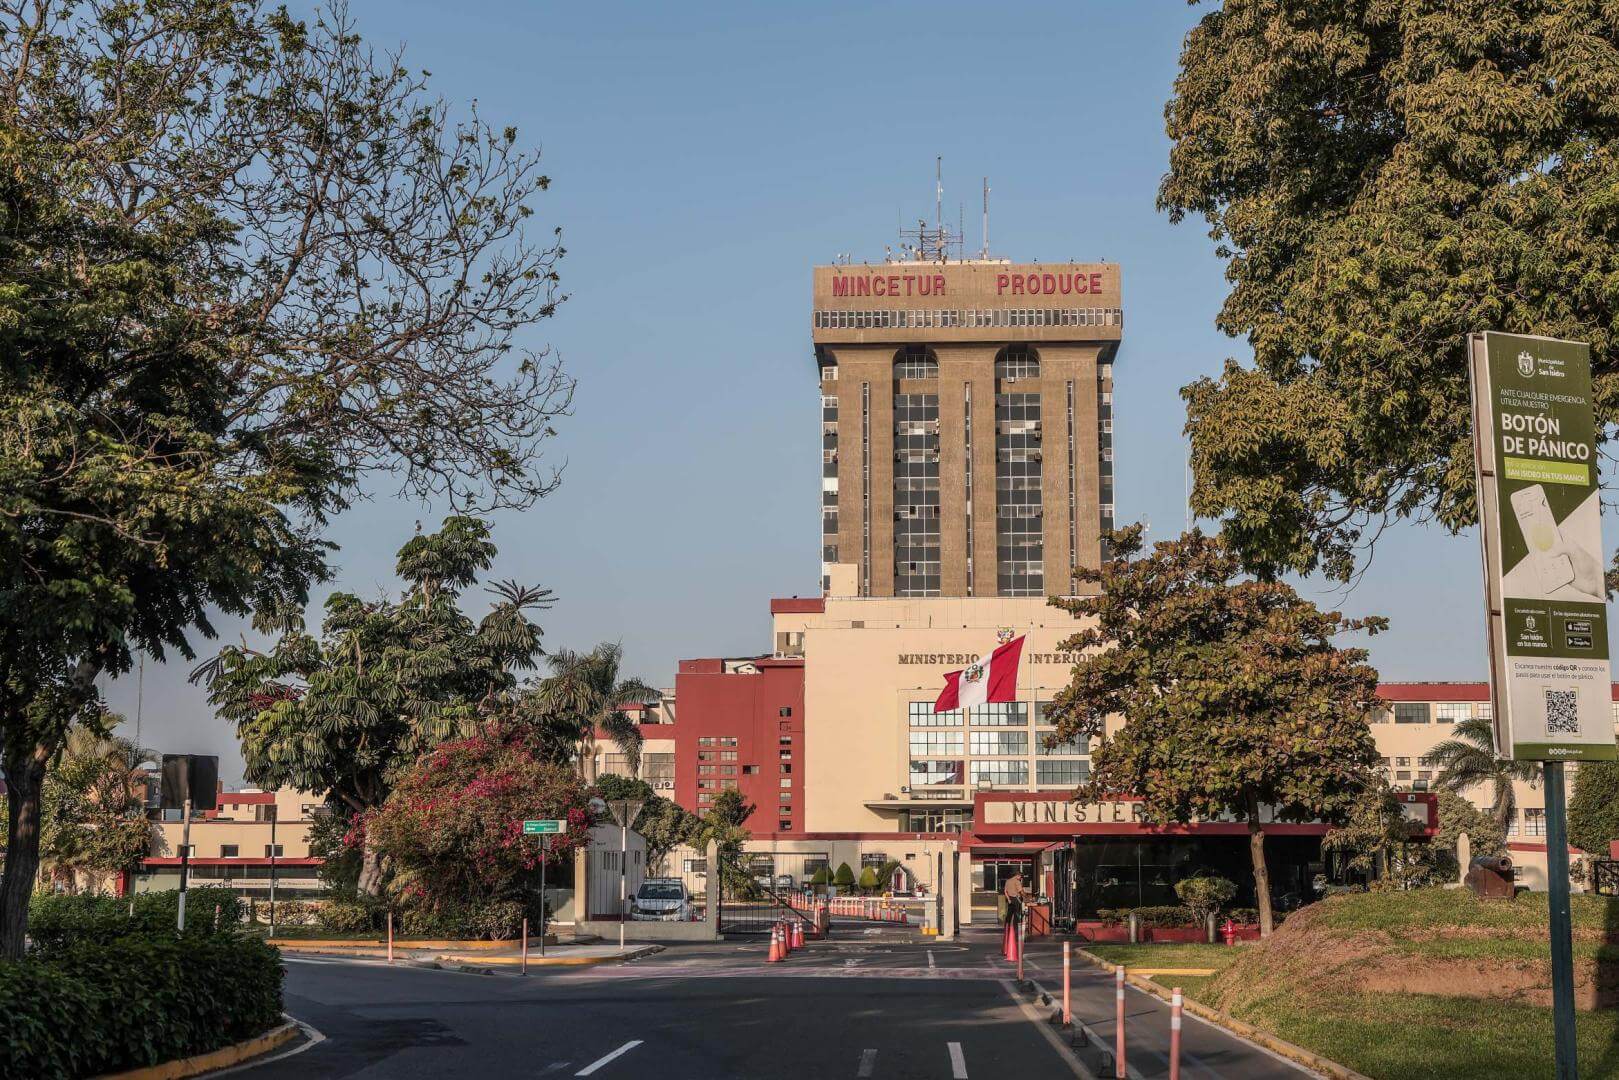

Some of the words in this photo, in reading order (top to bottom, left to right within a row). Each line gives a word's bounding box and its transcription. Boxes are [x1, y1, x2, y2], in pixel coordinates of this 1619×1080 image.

[832, 274, 946, 297] MINCETUR
[996, 272, 1103, 295] PRODUCE
[1538, 368, 1549, 376] San
[1550, 369, 1565, 378] Isidro
[1500, 388, 1516, 397] ANTE
[1516, 390, 1549, 401] CUALQUIER
[1500, 397, 1522, 407] UTILIZA
[1522, 400, 1550, 410] NUESTRO
[1501, 412, 1561, 436] BOTÓN
[1503, 435, 1525, 455] DE
[1528, 435, 1590, 461] PÁNICO
[898, 653, 980, 665] MINISTERIO
[1569, 664, 1578, 672] QR
[1011, 801, 1150, 823] MINISTER
